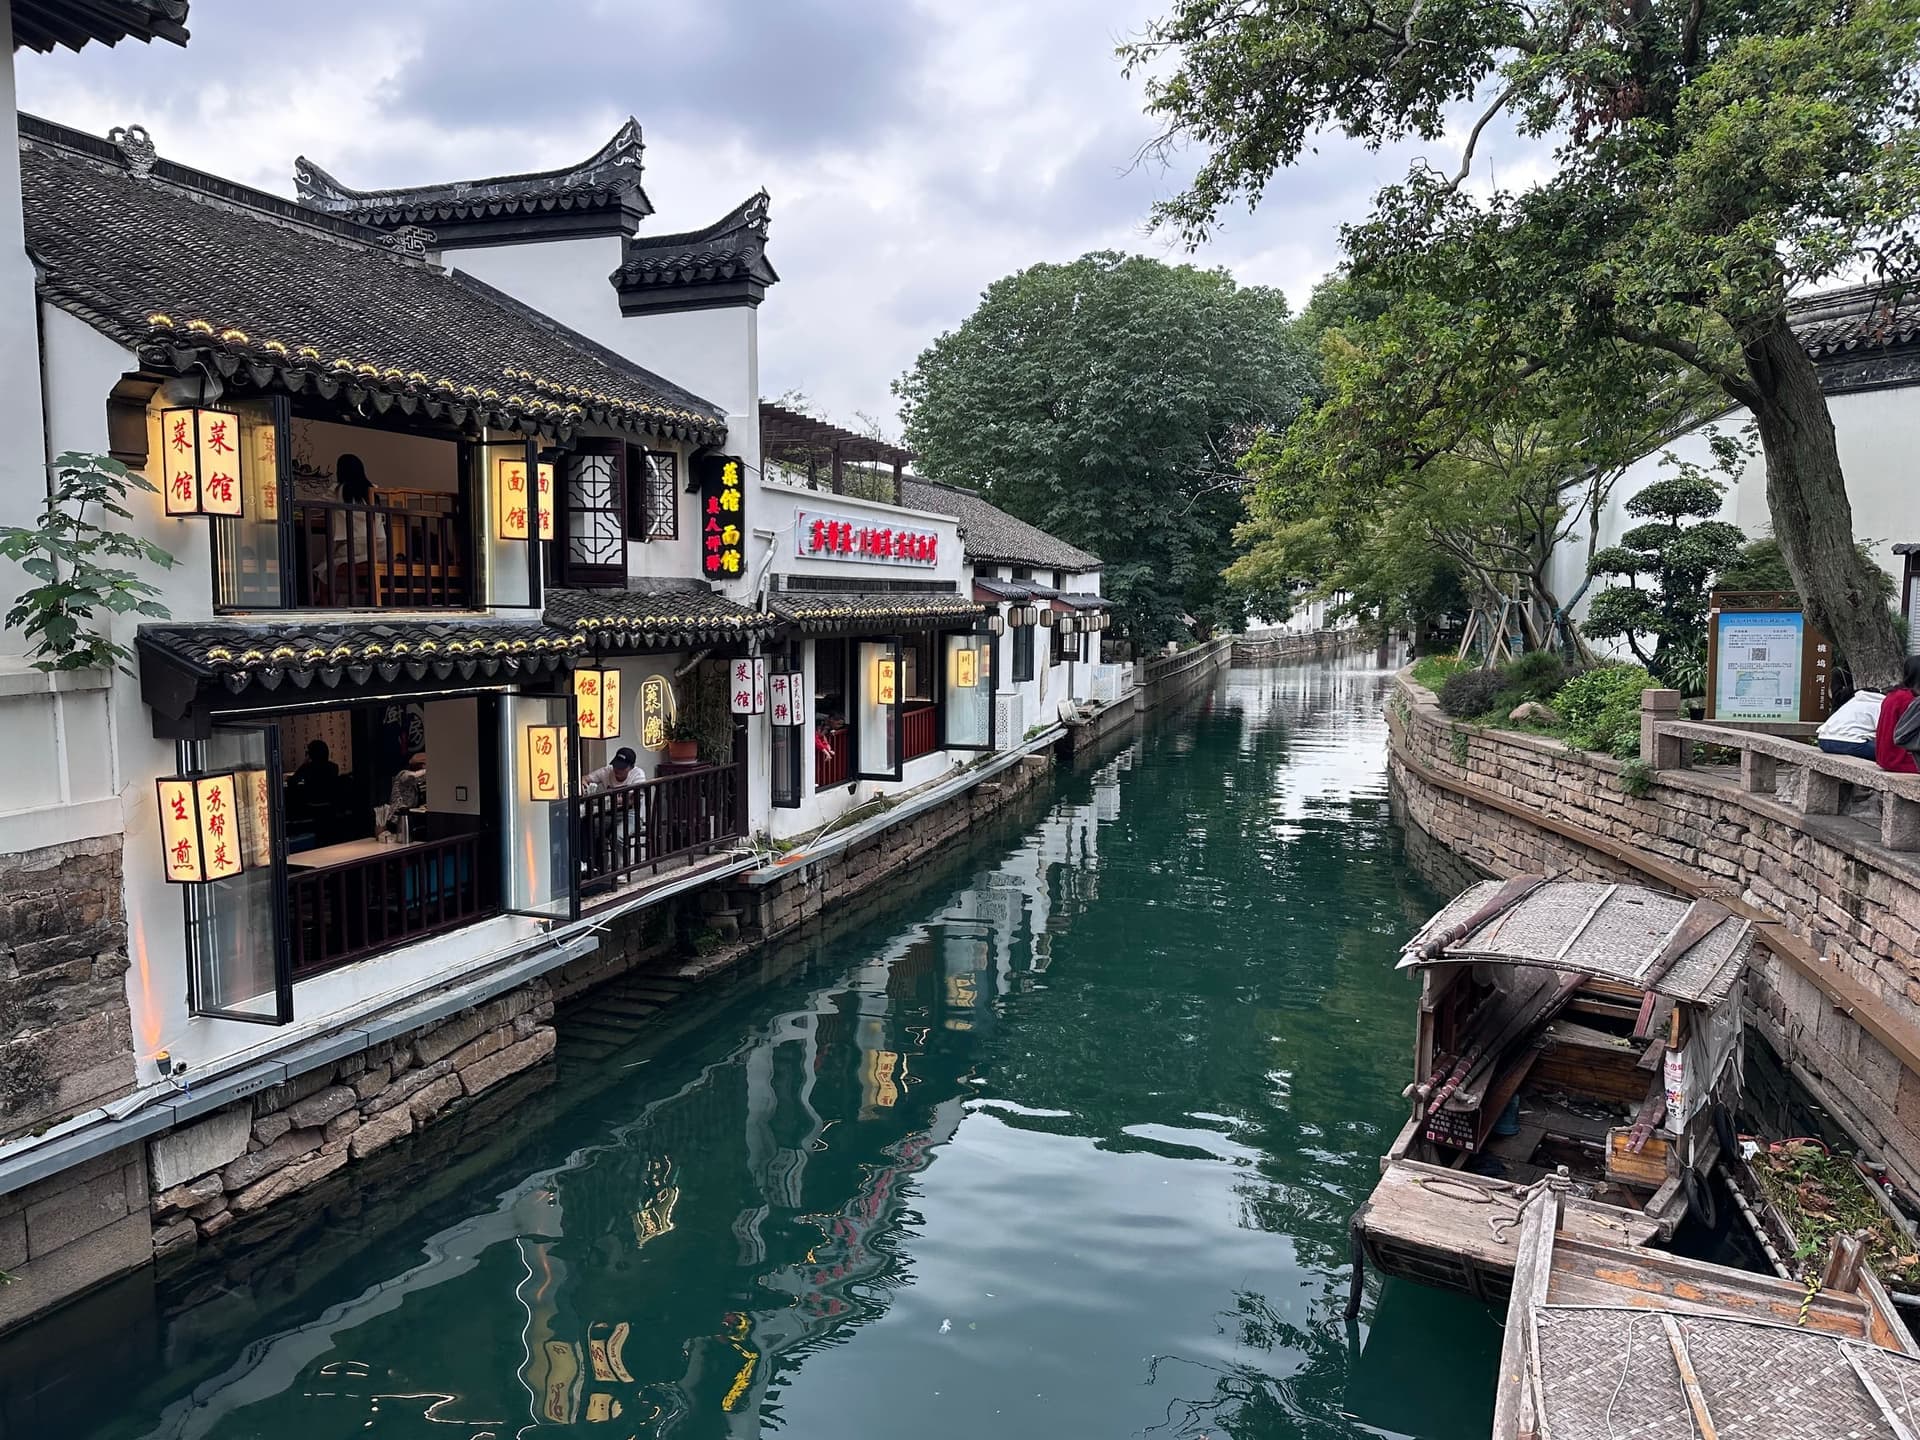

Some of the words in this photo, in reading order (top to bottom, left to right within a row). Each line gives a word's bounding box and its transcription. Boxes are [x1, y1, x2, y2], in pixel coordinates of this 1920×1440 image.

[171, 417, 193, 501] 菜馆
[205, 419, 235, 503] 菜馆
[505, 470, 526, 529] 面馆
[578, 677, 598, 729] 馄饨
[735, 662, 751, 707] 菜馆
[535, 735, 554, 791] 汤包
[171, 790, 193, 871] 生煎
[205, 784, 233, 871] 苏帮菜
